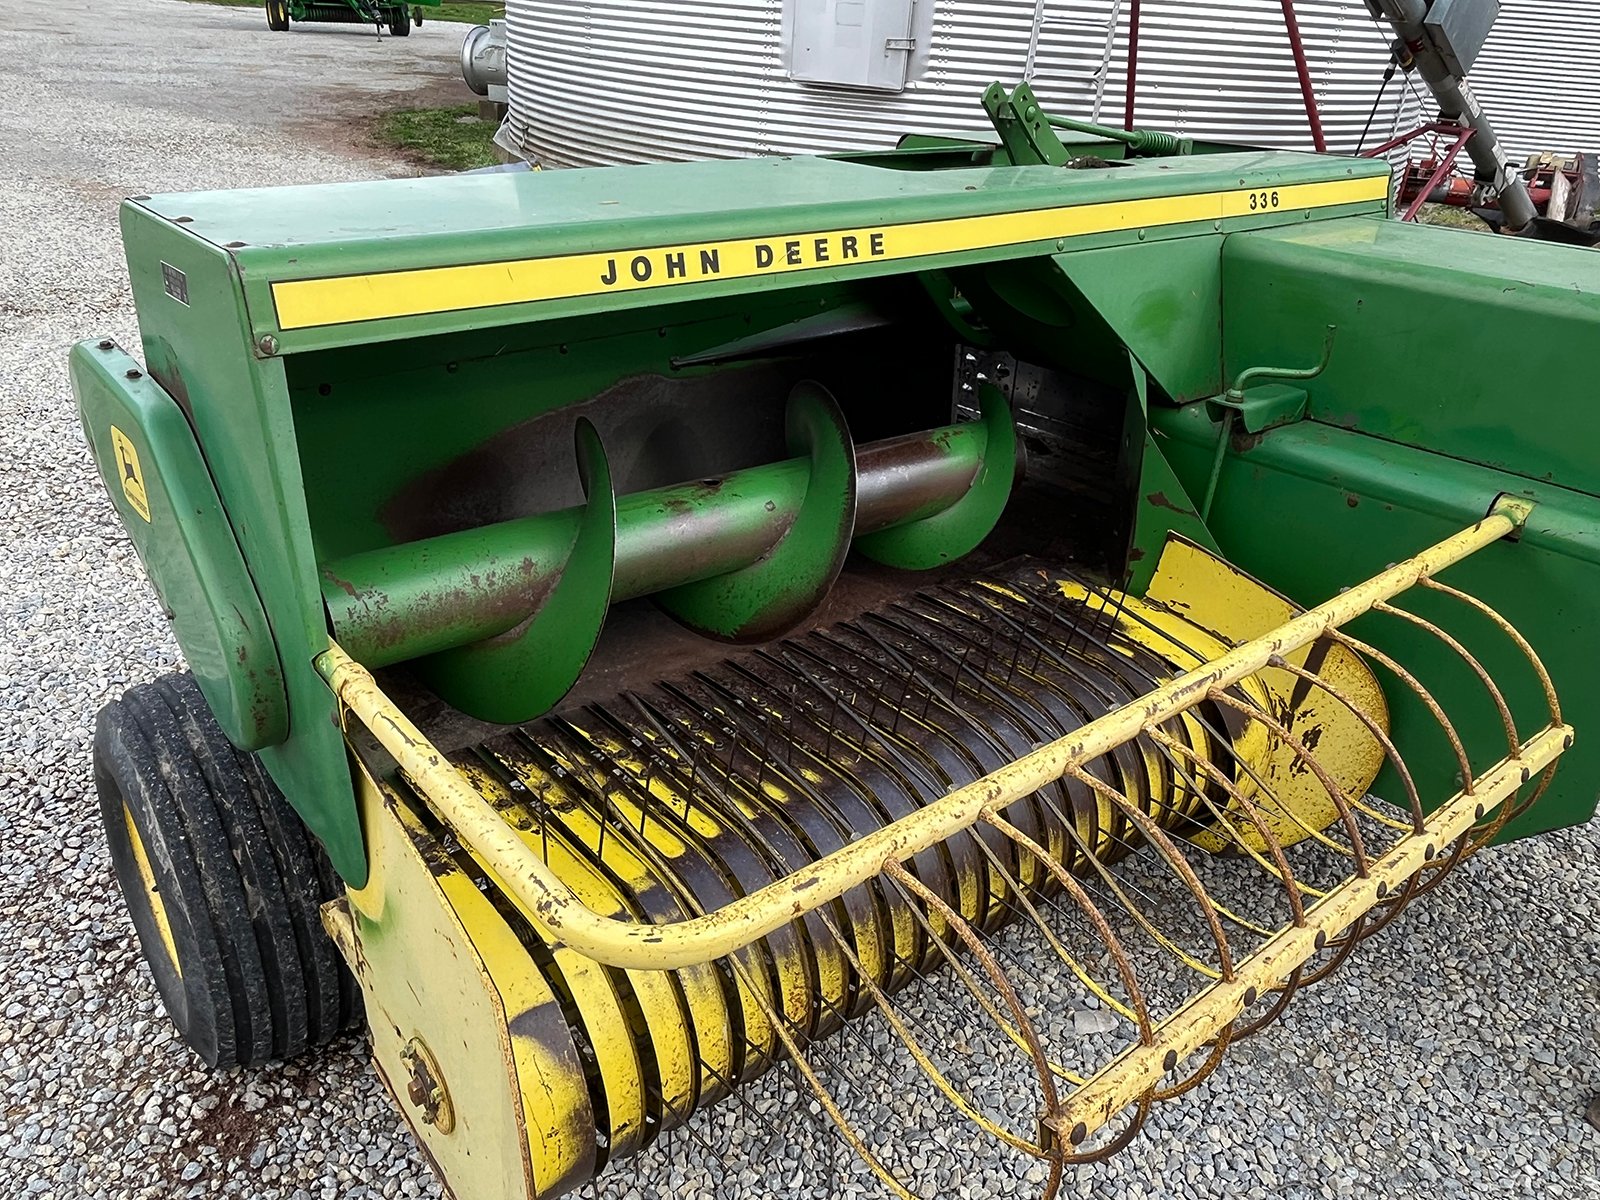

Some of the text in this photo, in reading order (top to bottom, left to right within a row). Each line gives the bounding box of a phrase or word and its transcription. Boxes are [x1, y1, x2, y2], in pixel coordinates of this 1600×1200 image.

[1249, 191, 1279, 210] 336
[600, 233, 885, 285] JOHN DEERE
